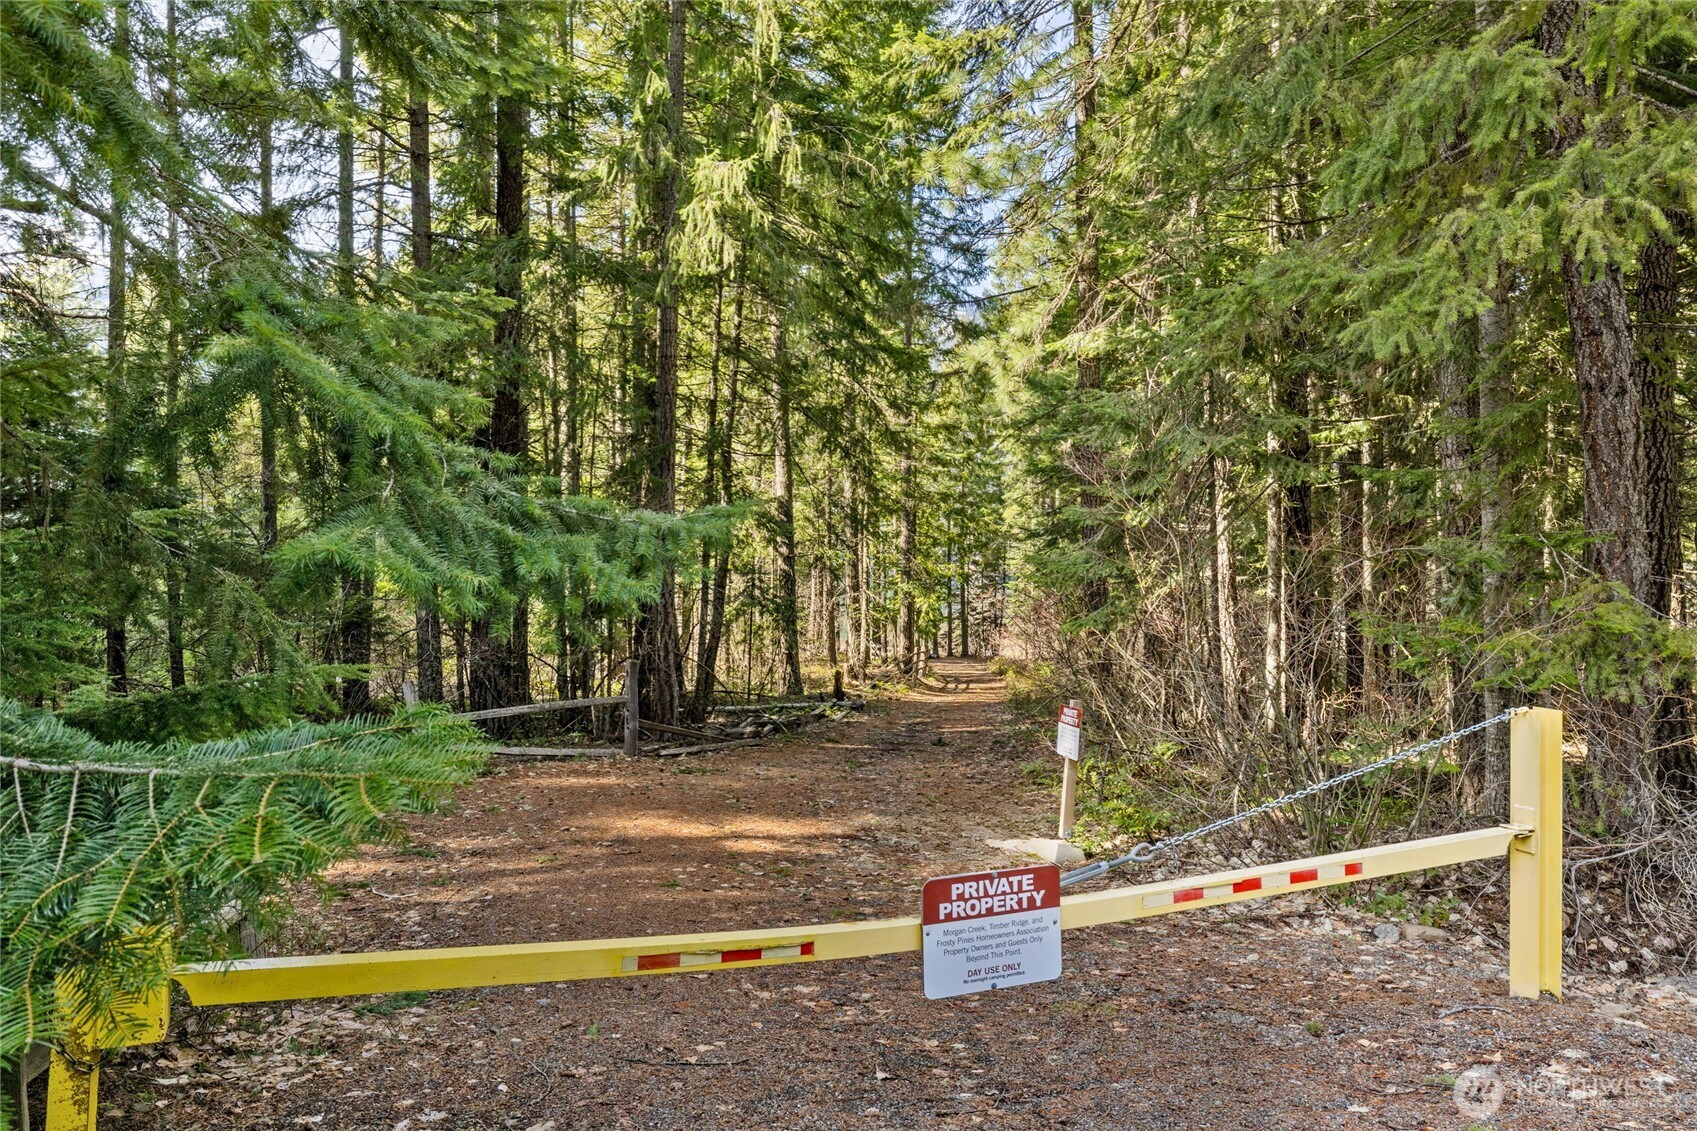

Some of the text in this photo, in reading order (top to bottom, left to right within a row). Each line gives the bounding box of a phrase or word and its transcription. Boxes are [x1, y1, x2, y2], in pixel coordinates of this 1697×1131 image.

[951, 874, 1034, 900] PRIVATE
[939, 890, 1046, 920] PROPERTY
[937, 925, 1049, 947] Frosty Pines Homeowners Association
[943, 928, 966, 937] Morgan
[968, 925, 987, 934] Creek,
[990, 920, 1010, 930] Timber
[1011, 918, 1030, 928] Ridge,
[943, 935, 1043, 956] Property Owners and Guests Only
[966, 948, 1022, 963] Beyond This Point.
[968, 962, 1021, 978] DAY USE ONLY
